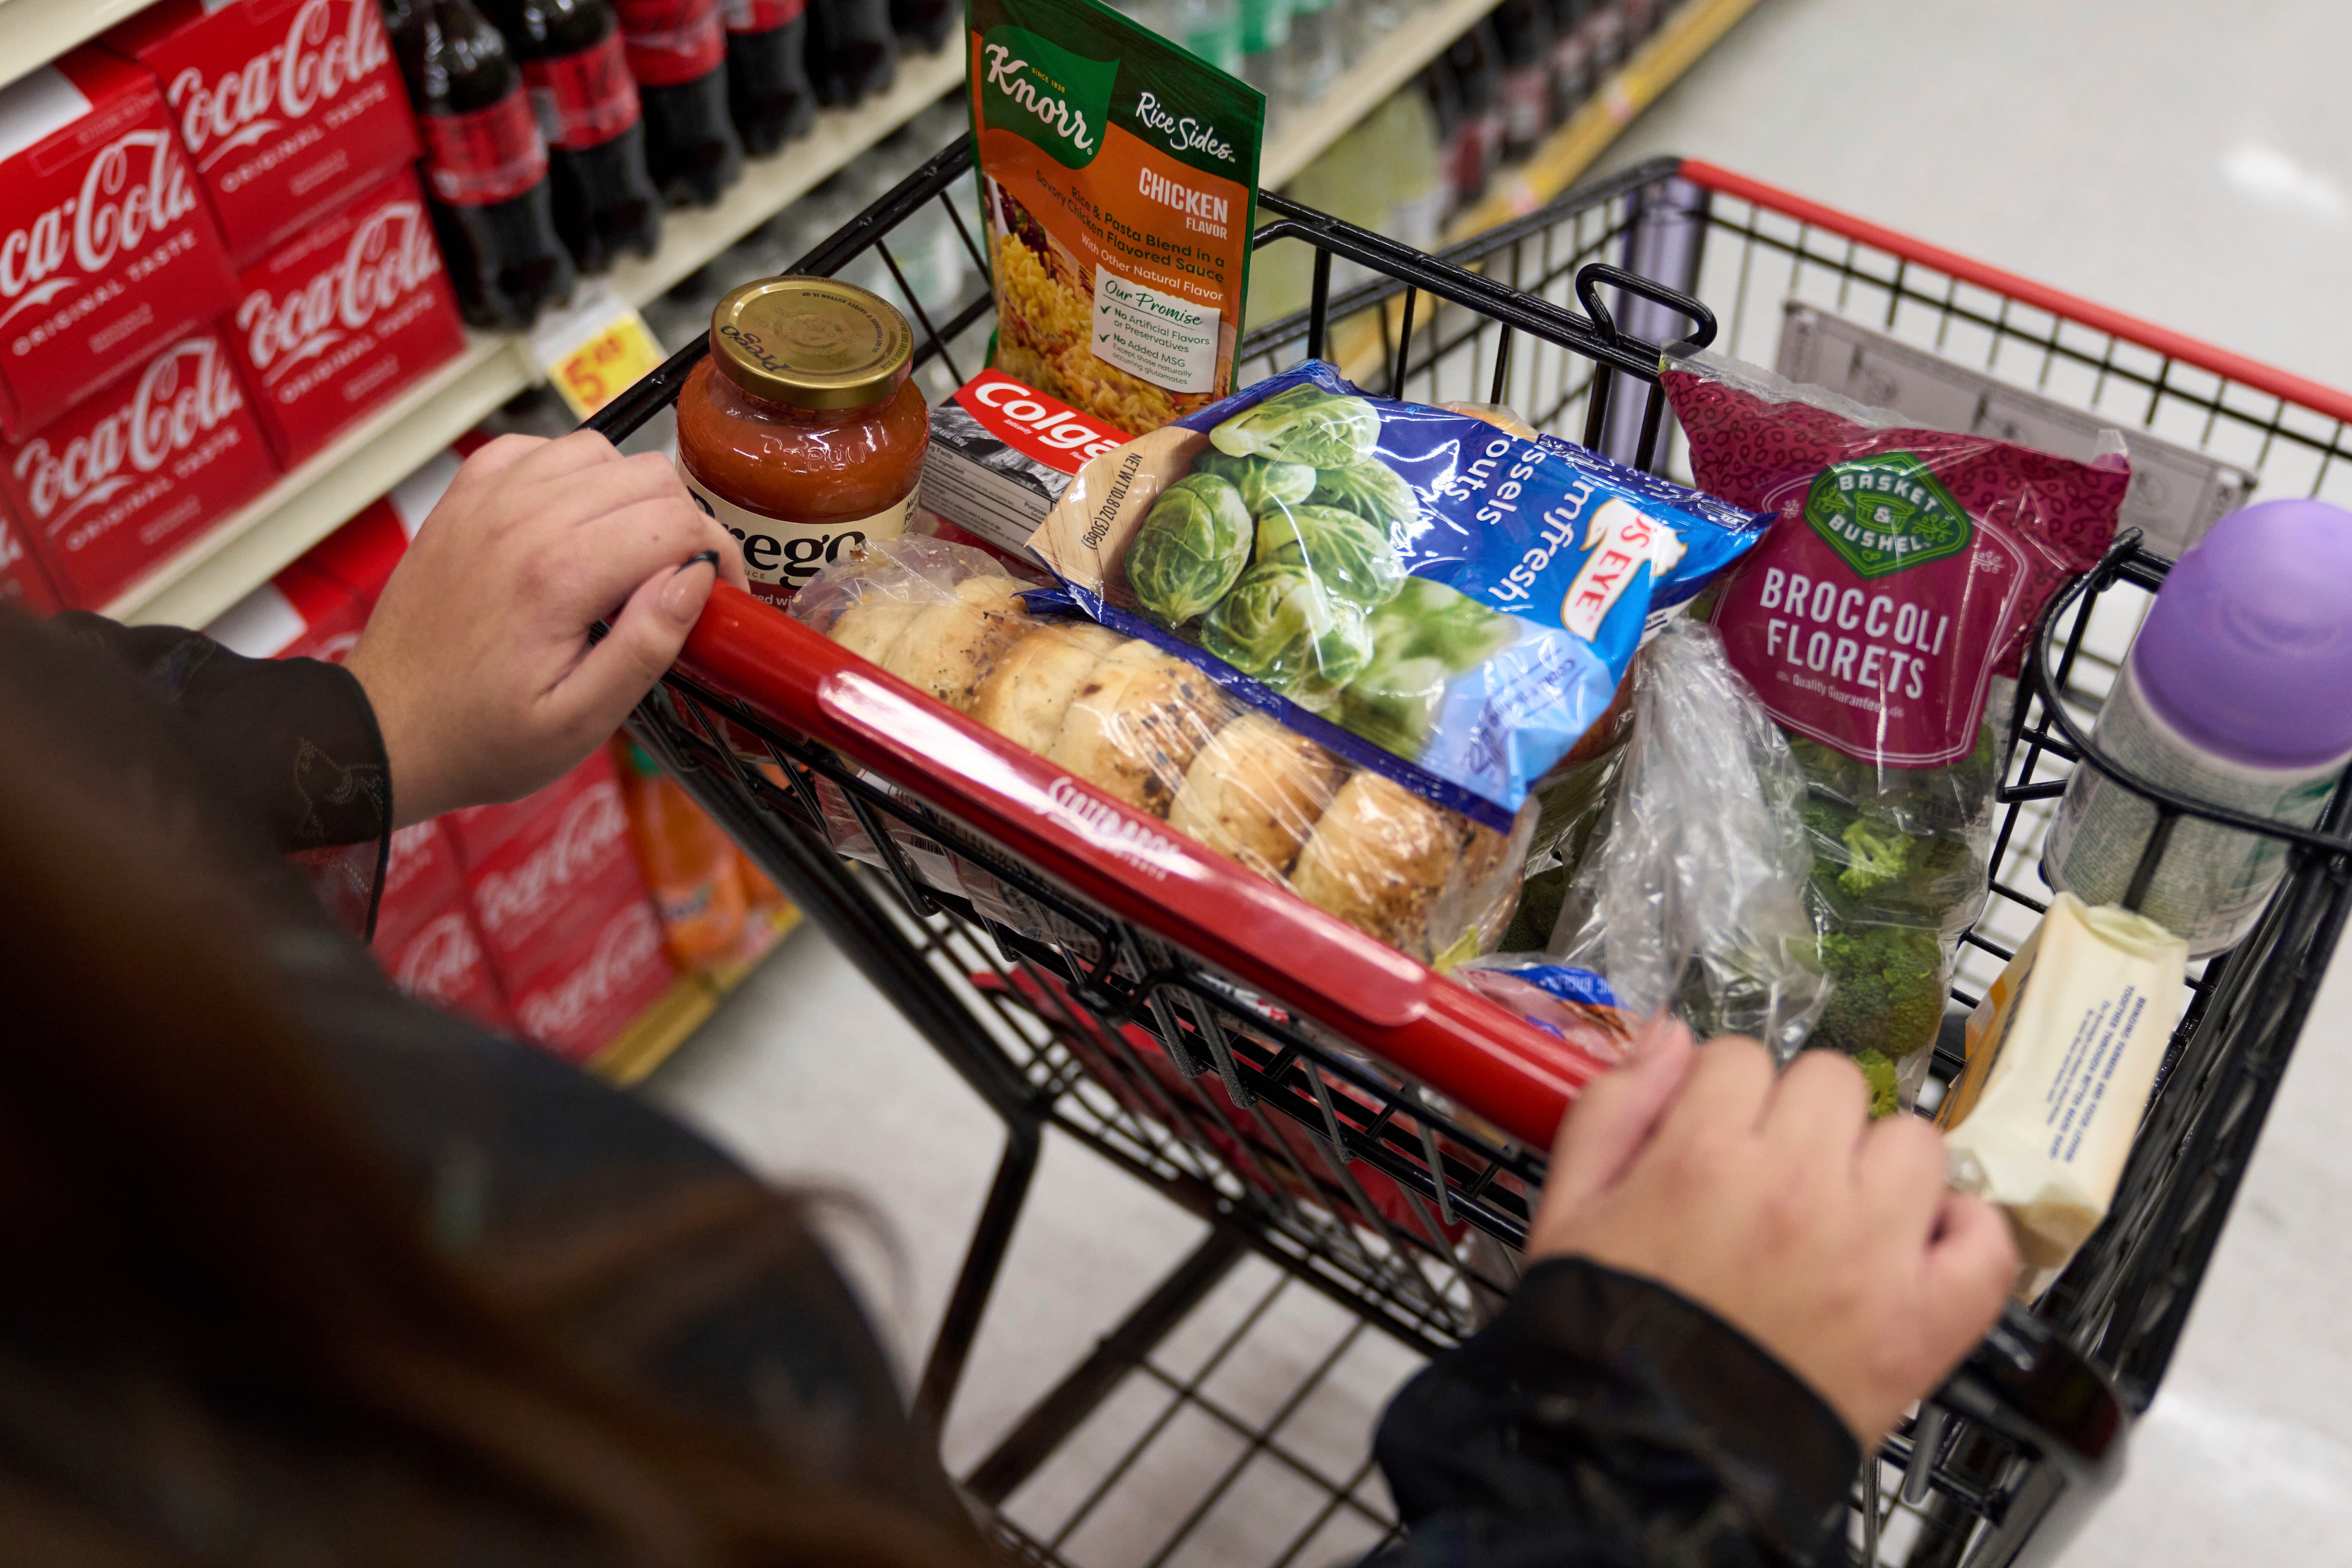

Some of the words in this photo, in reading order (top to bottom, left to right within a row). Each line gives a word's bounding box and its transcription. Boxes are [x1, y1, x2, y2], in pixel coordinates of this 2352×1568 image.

[167, 0, 389, 153] Coca-Cola
[985, 44, 1094, 150] Knorr
[1031, 67, 1049, 84] SINCE
[1051, 77, 1065, 94] 1838
[221, 125, 326, 193] ORIGINAL
[323, 81, 389, 129] TASTE
[1136, 91, 1176, 135] Rice
[1170, 118, 1233, 160] Sides
[0, 129, 196, 297] ca-Cola
[1139, 167, 1229, 223] CHICKEN
[1036, 169, 1066, 208] Savory
[1067, 200, 1104, 239] Chicken
[1107, 231, 1171, 267] Flavored
[1176, 258, 1224, 284] Sauce
[1071, 186, 1092, 211] Rice
[1093, 206, 1102, 219] &
[1104, 214, 1142, 243] Pasta
[1145, 232, 1193, 259] Blend
[1196, 247, 1211, 263] in
[1215, 257, 1225, 269] a
[1185, 216, 1228, 240] FLAVOR
[237, 202, 442, 370] Coca-Cola
[1081, 232, 1100, 256] With
[1101, 249, 1130, 274] Other
[1133, 265, 1181, 290] Natural
[1183, 281, 1224, 302] Flavor
[12, 278, 126, 356] ORIGINAL
[125, 229, 197, 282] TASTE
[821, 293, 847, 303] BUTTON
[847, 301, 868, 314] SAFETY
[1105, 279, 1134, 301] Our
[1136, 292, 1204, 326] Promise
[1113, 319, 1124, 329] or
[1124, 323, 1190, 355] Preservatives
[1114, 307, 1128, 321] No
[1128, 312, 1170, 338] Artificial
[1172, 328, 1211, 346] Flavors
[721, 325, 792, 373] Prego
[1112, 342, 1136, 360] Except
[1136, 350, 1155, 365] those
[1157, 359, 1193, 379] naturally
[1112, 352, 1144, 372] occurring
[1144, 361, 1189, 385] glutamates
[1113, 333, 1126, 346] No
[1127, 338, 1160, 361] Added
[1161, 351, 1186, 368] MSG
[13, 337, 243, 519] Coca-Cola
[975, 382, 1122, 457] Colga
[1002, 419, 1033, 436] Anticavity
[1069, 451, 1090, 463] Fluori
[951, 435, 969, 449] (130g)
[1125, 452, 1144, 475] NET
[1106, 485, 1127, 508] 10.8
[1118, 470, 1133, 490] WT
[1475, 444, 1547, 526] ssels
[1838, 474, 1939, 513] BASKET
[1023, 501, 1049, 518] Purpose
[1099, 505, 1118, 523] OZ
[1872, 505, 1892, 524] &
[1081, 517, 1111, 550] (306g)
[1488, 474, 1596, 602] mfresh
[1828, 514, 1922, 552] BUSHEL
[745, 569, 766, 579] UCE
[1575, 550, 1630, 613] EYE
[1759, 567, 1949, 656] BROCCOLI
[1766, 618, 1927, 700] FLORETS
[1792, 673, 1828, 700] Quality
[1828, 684, 1885, 715] Guarantee
